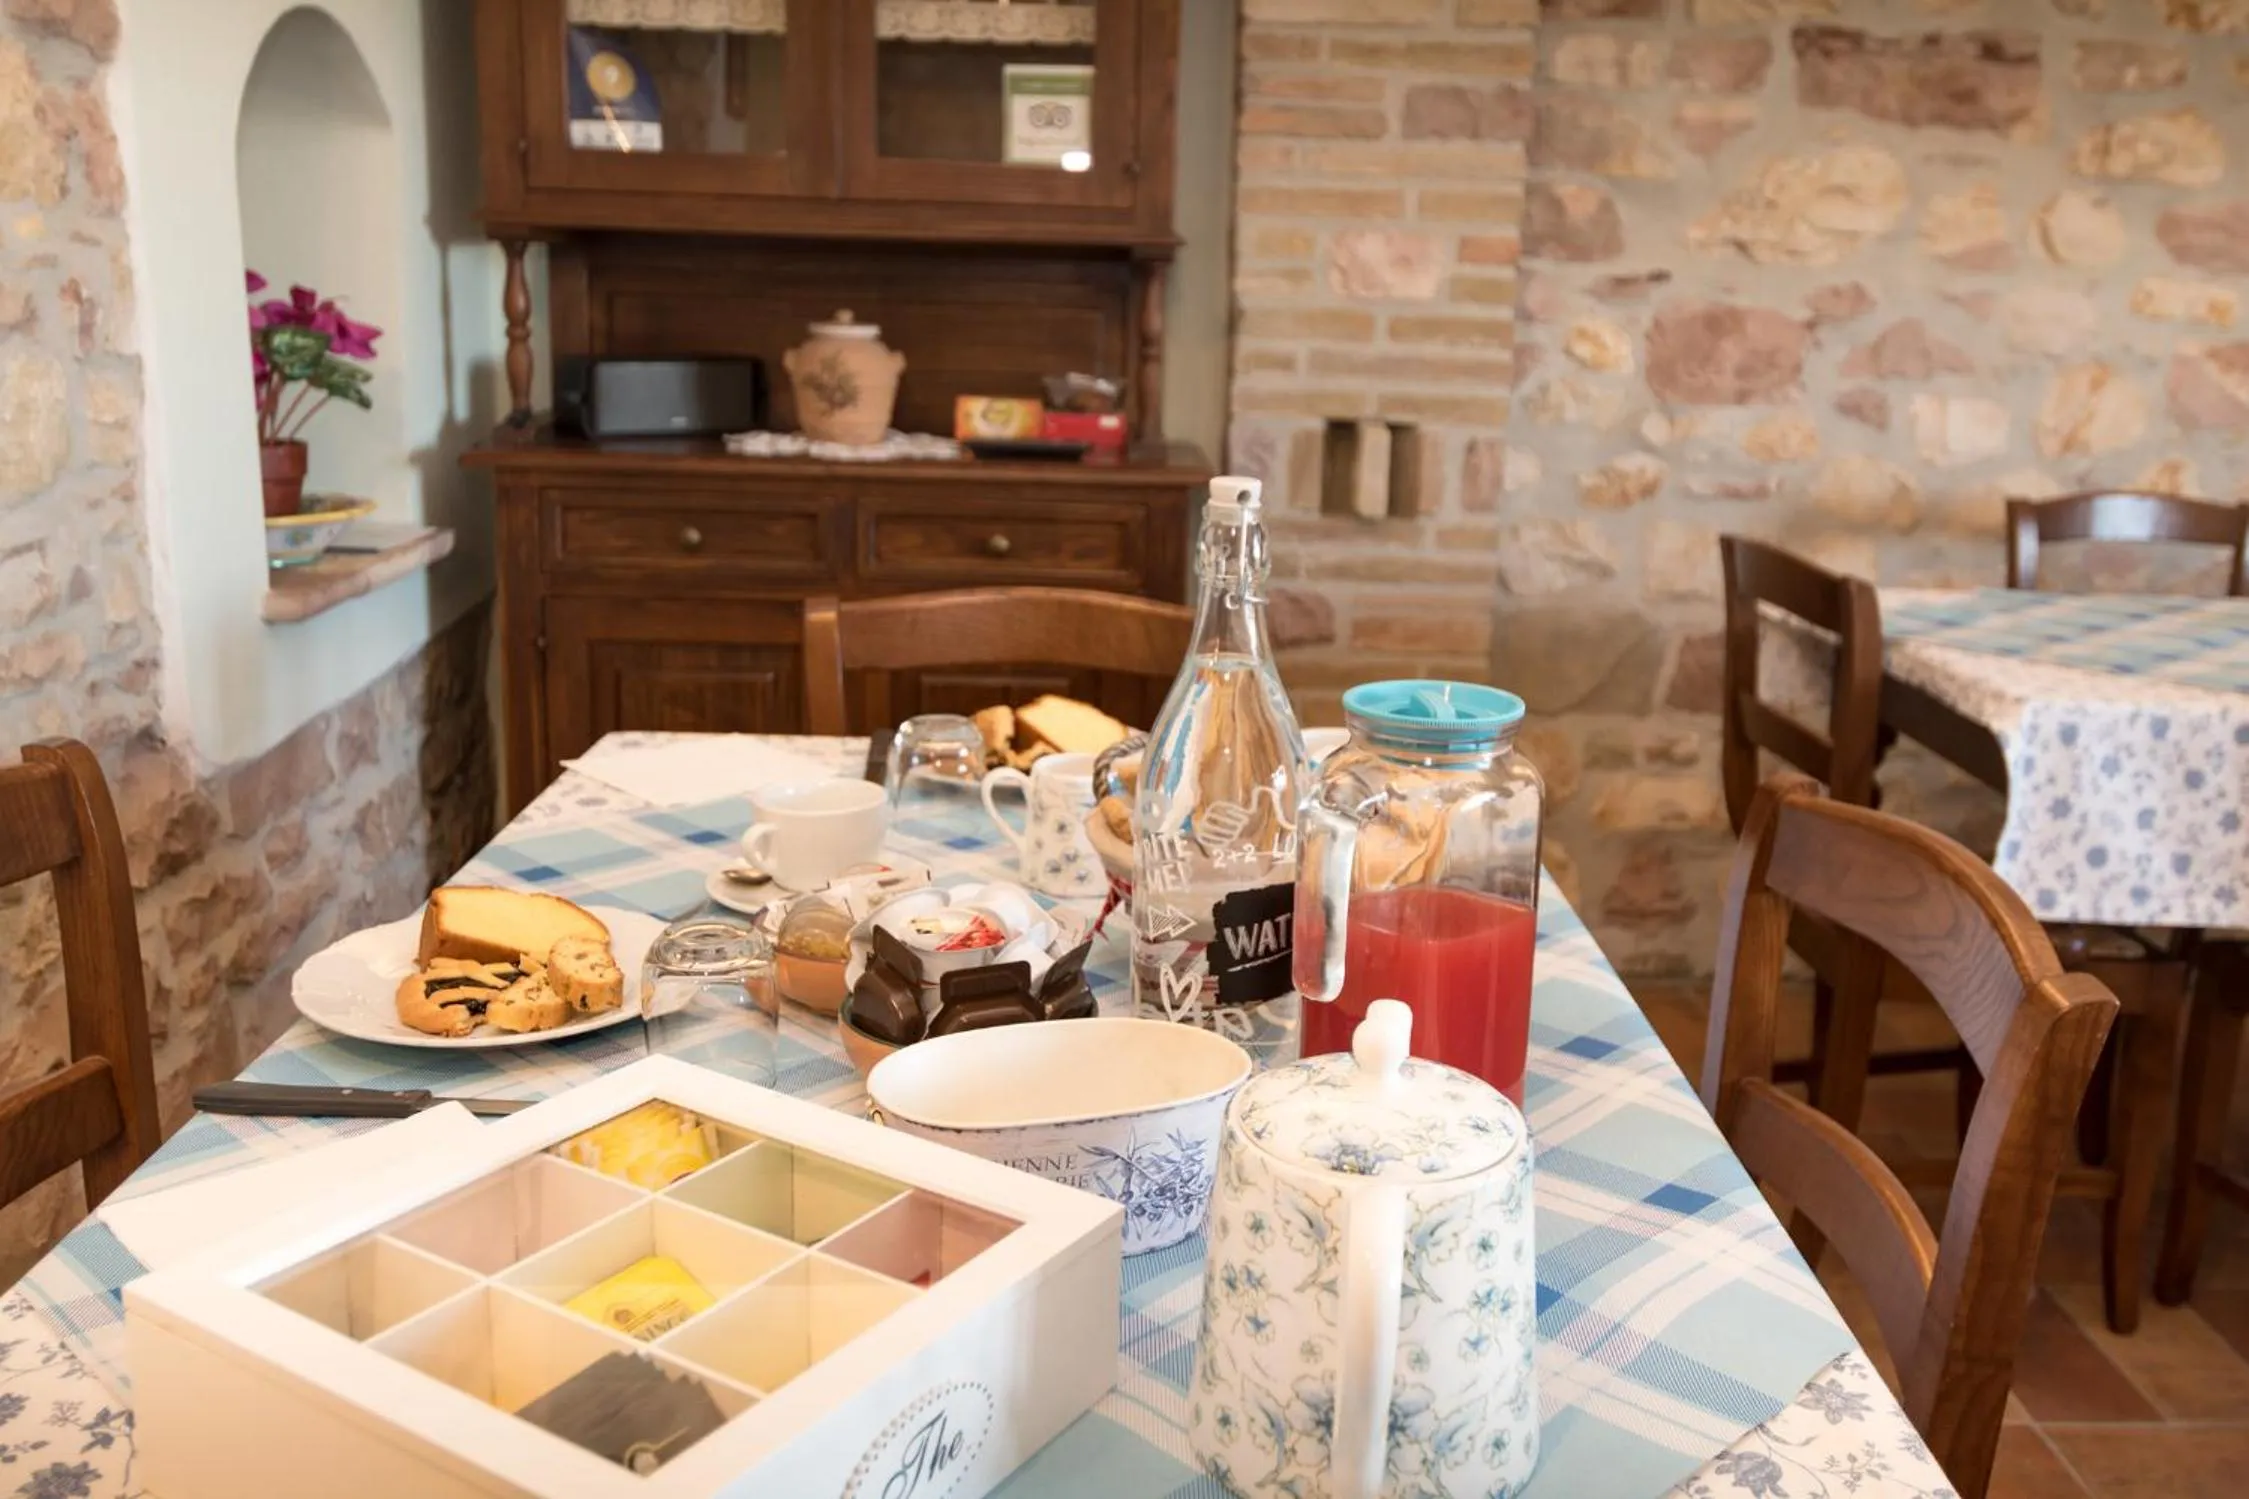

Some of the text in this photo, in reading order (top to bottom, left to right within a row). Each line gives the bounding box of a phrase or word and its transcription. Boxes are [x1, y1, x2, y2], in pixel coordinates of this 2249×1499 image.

[1212, 843, 1257, 869] 2+2
[1223, 912, 1292, 960] WAT
[882, 1409, 963, 1499] The
